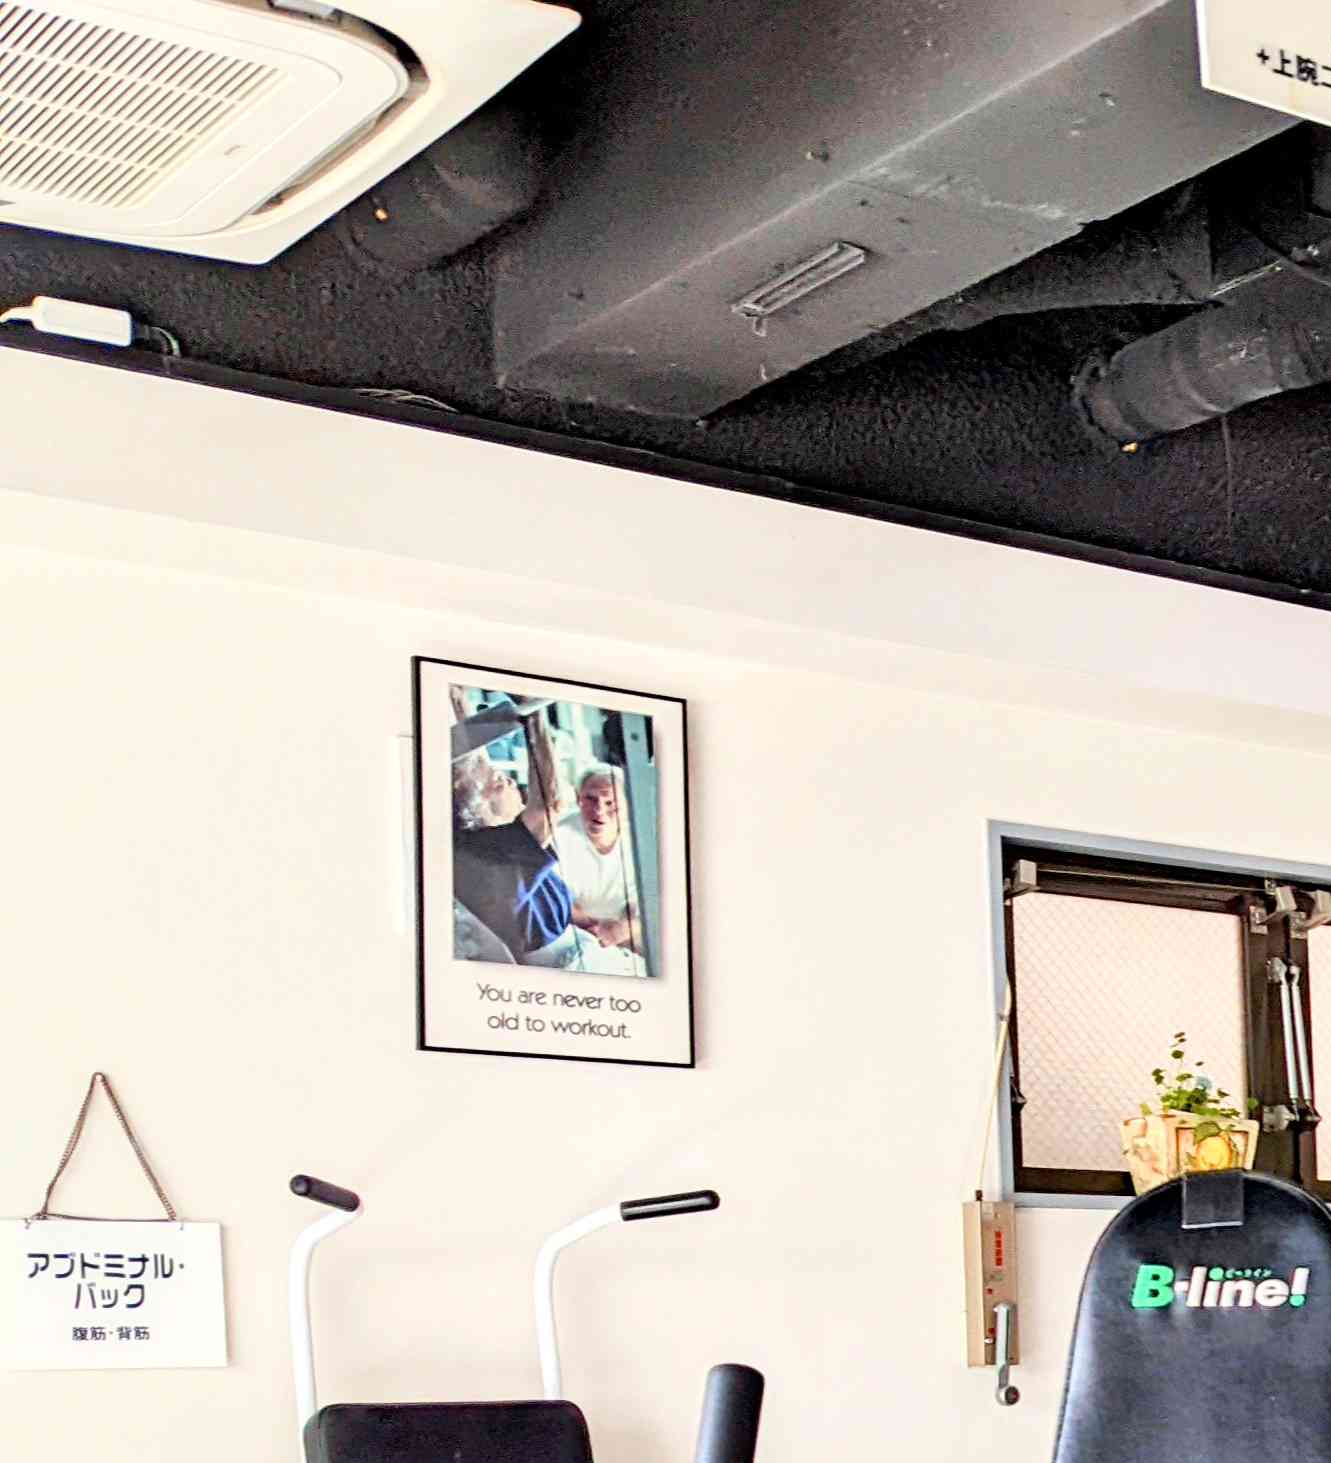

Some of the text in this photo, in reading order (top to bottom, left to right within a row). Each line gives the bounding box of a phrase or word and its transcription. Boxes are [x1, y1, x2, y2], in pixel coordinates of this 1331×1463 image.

[476, 982, 641, 1014] You are never too
[487, 1011, 631, 1040] old to workout.
[74, 1282, 146, 1309] バック
[1130, 1264, 1310, 1309] B-line!
